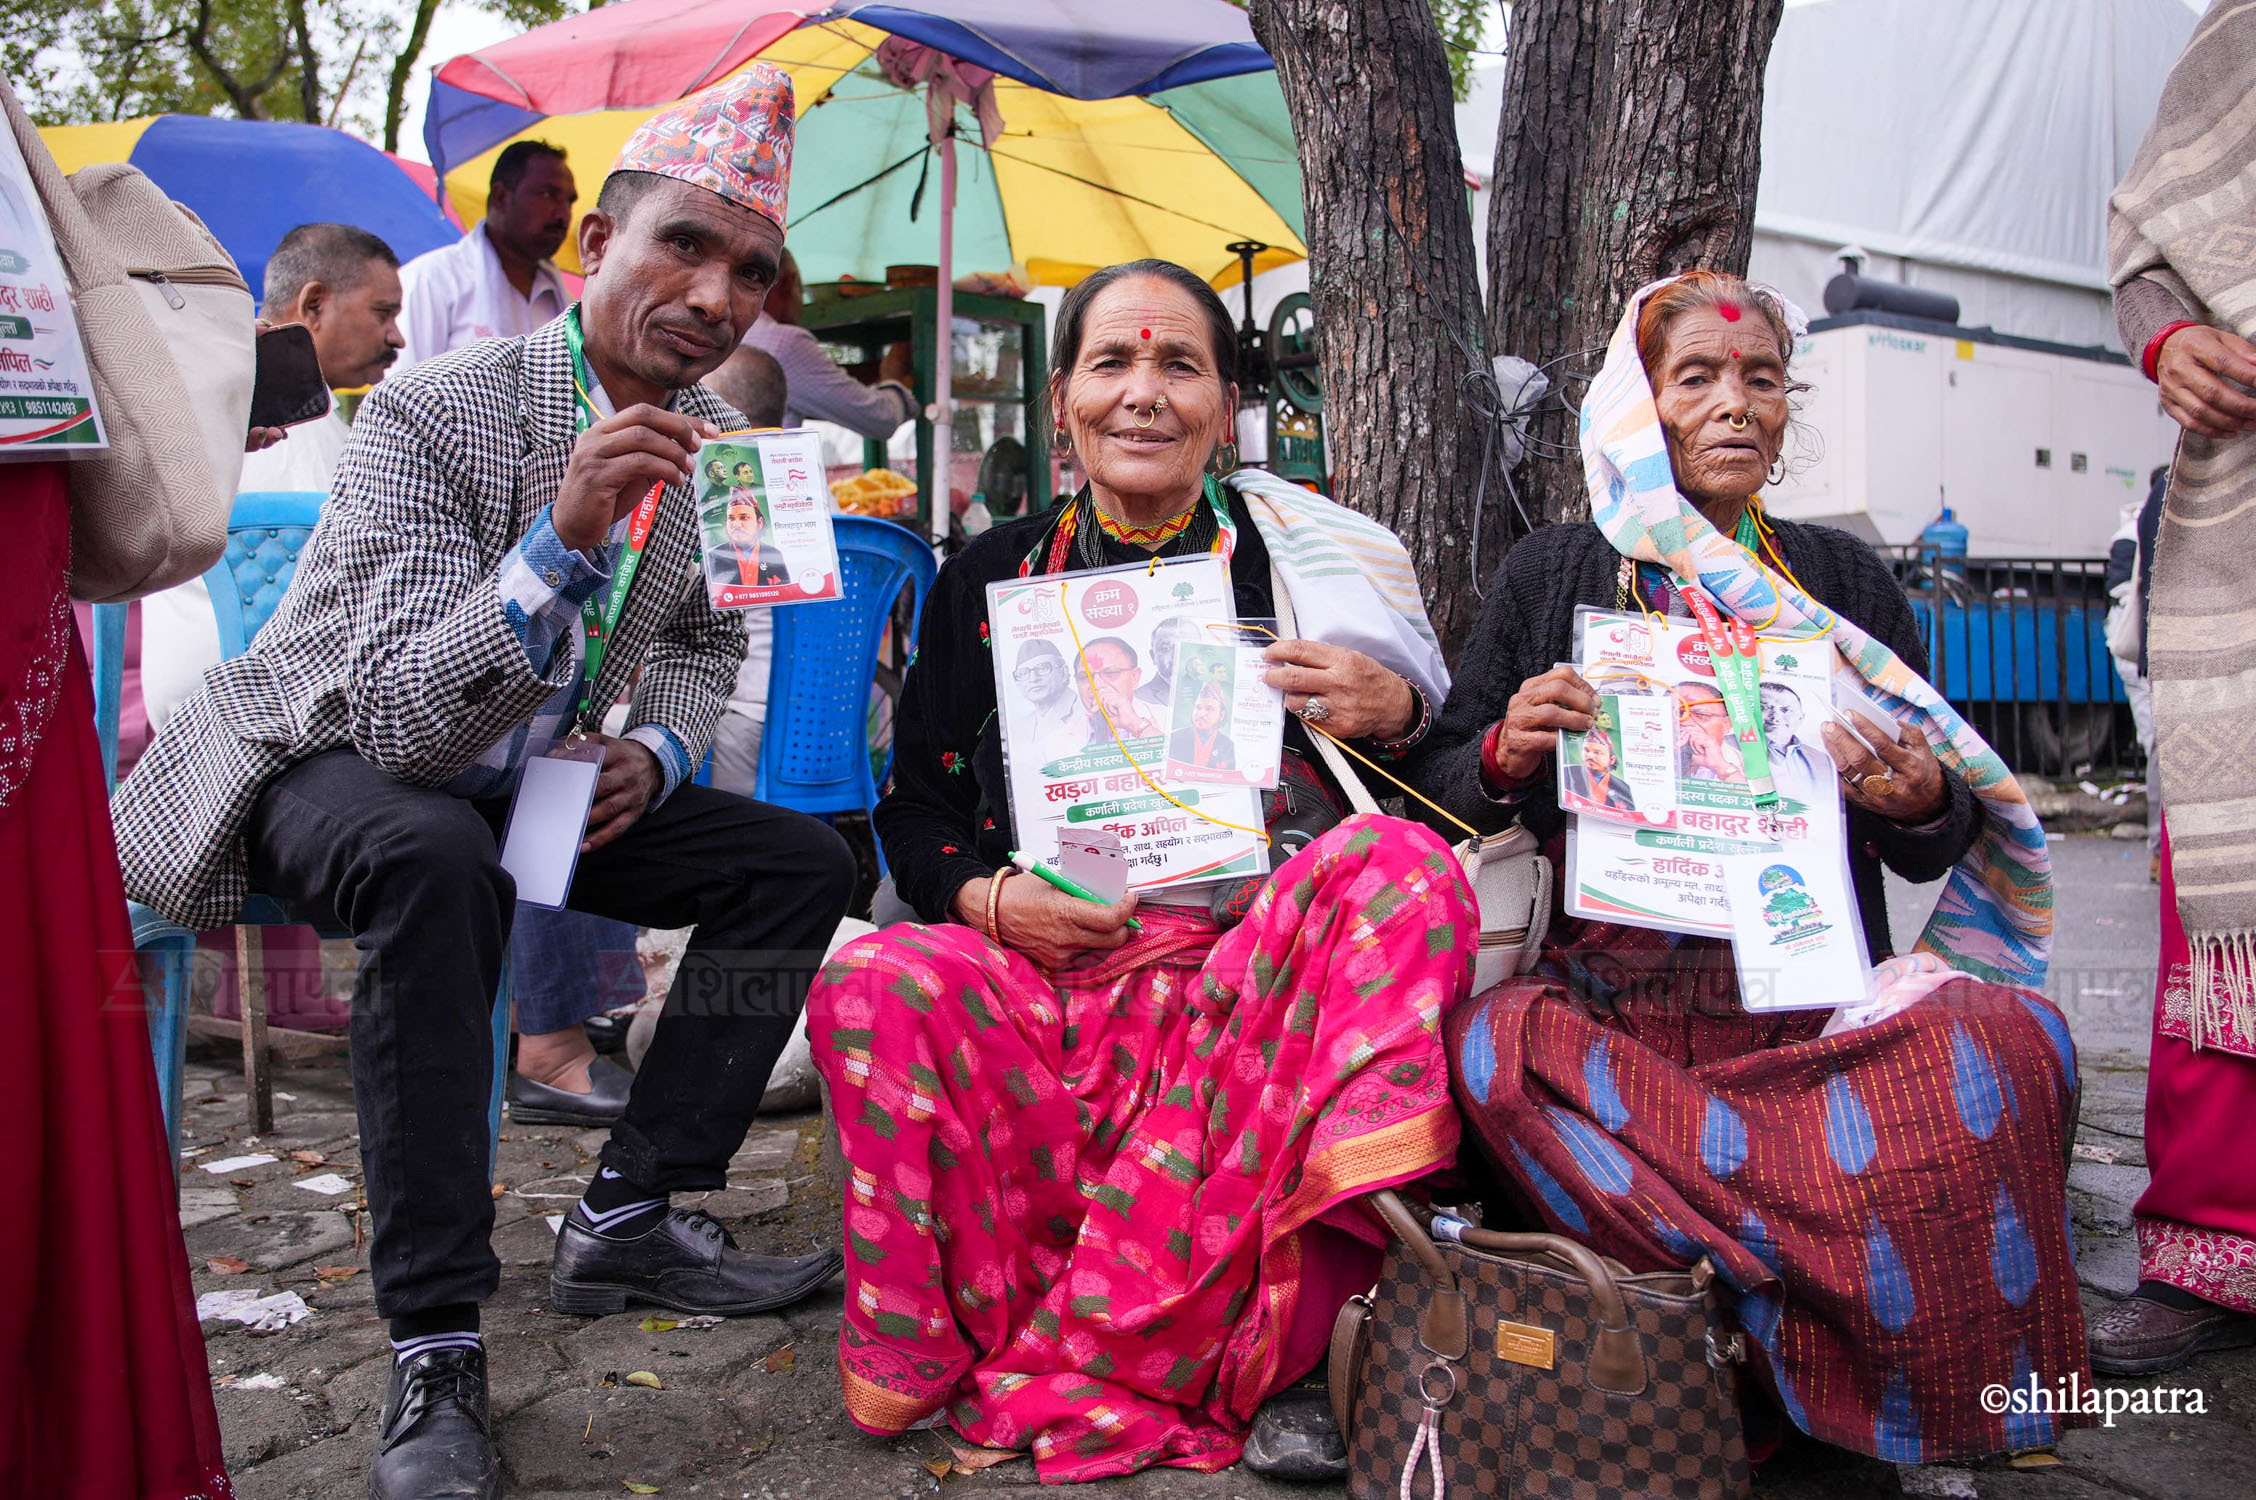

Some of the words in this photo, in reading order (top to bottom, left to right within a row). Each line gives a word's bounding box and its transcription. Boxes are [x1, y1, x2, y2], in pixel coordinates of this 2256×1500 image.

[21, 283, 55, 312] शाही
[25, 401, 77, 415] 9851142493
[604, 589, 623, 625] नेपाली
[616, 552, 636, 590] कांग्रेस
[1094, 587, 1121, 603] क्रम
[1085, 603, 1123, 620] संख्या
[1691, 638, 1708, 651] क्र
[1727, 693, 1749, 724] नेपाली
[1058, 757, 1092, 773] केन्द्रीय
[1094, 753, 1124, 768] सदस्य
[1707, 793, 1739, 806] पदका
[1085, 801, 1120, 818] कर्णाली
[1123, 800, 1147, 813] प्रदेश
[1140, 815, 1188, 836] अपिल
[1681, 810, 1751, 837] बहादुर
[1155, 837, 1184, 849] सहयोग
[1655, 834, 1695, 849] कर्णाली
[1652, 856, 1710, 877] हार्दिक
[1653, 877, 1681, 889] अमूल्य
[1678, 894, 1707, 906] अपेक्षा
